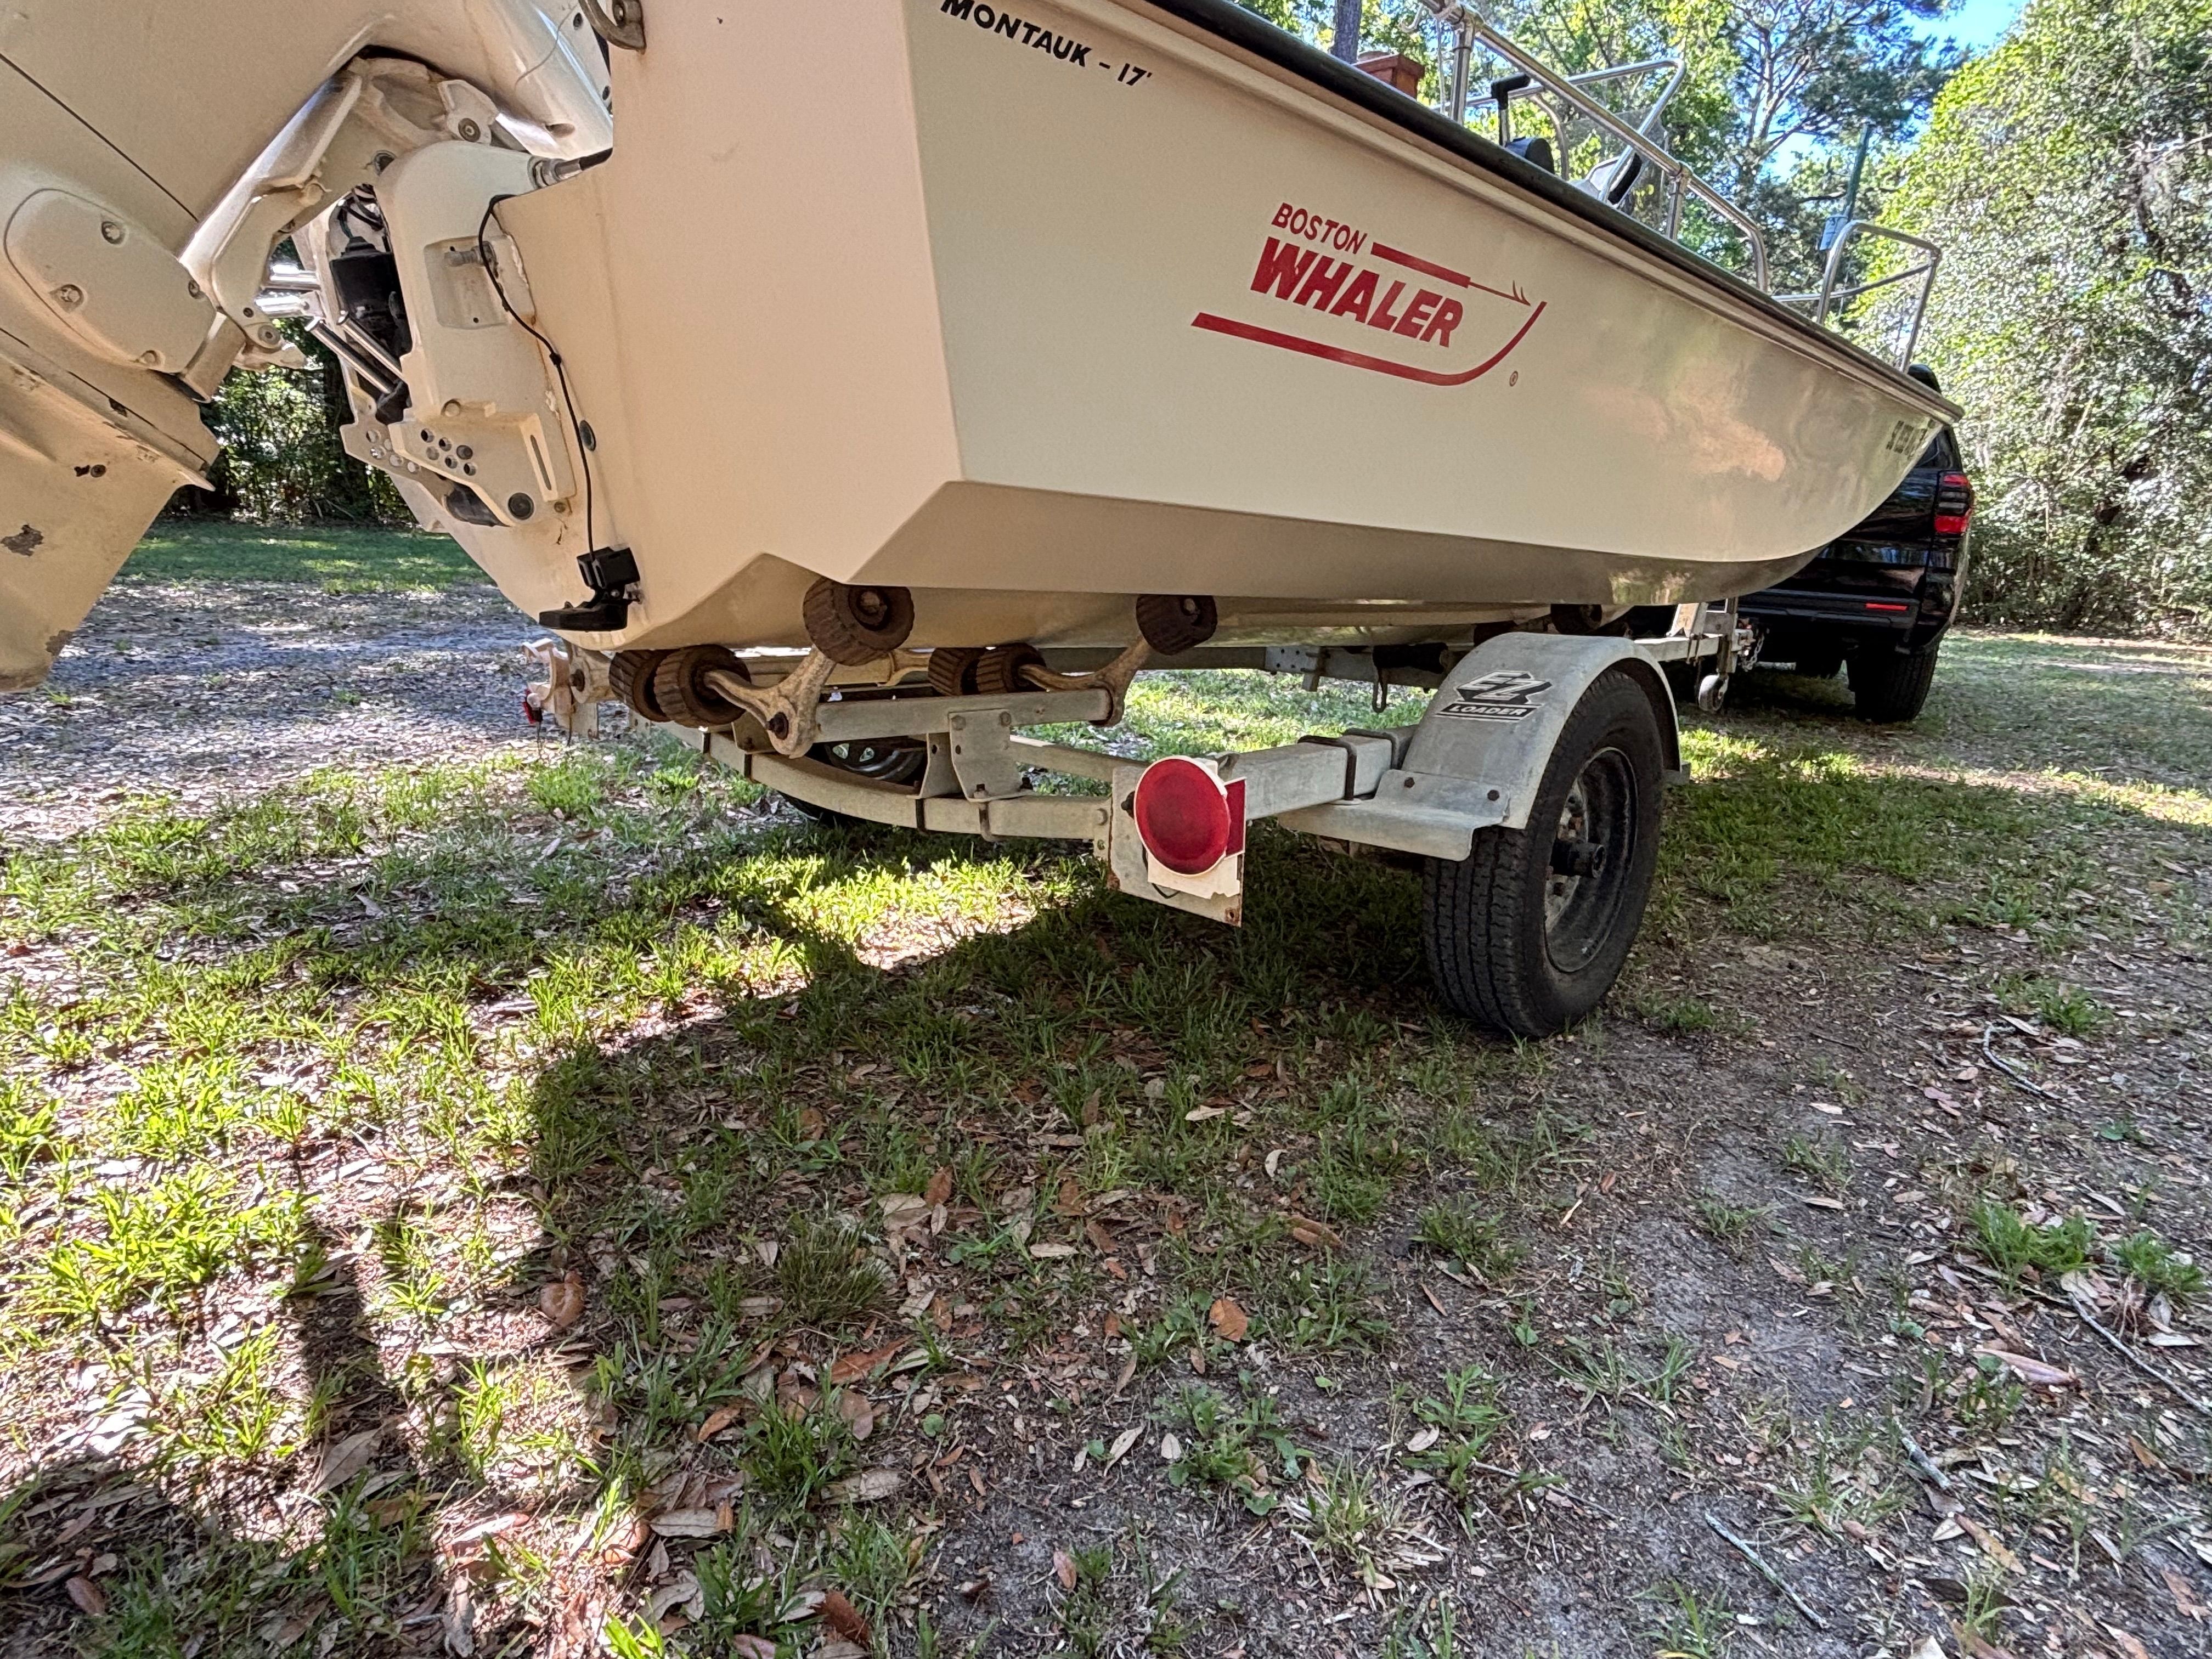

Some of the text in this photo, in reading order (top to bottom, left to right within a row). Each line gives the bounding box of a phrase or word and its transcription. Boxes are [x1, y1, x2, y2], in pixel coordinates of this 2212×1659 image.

[940, 0, 1092, 67] MONTAUK
[1271, 202, 1367, 255] BOSTON
[1250, 236, 1463, 348] WHALER
[1448, 706, 1527, 716] LOADER
[1456, 670, 1552, 704] EZ
